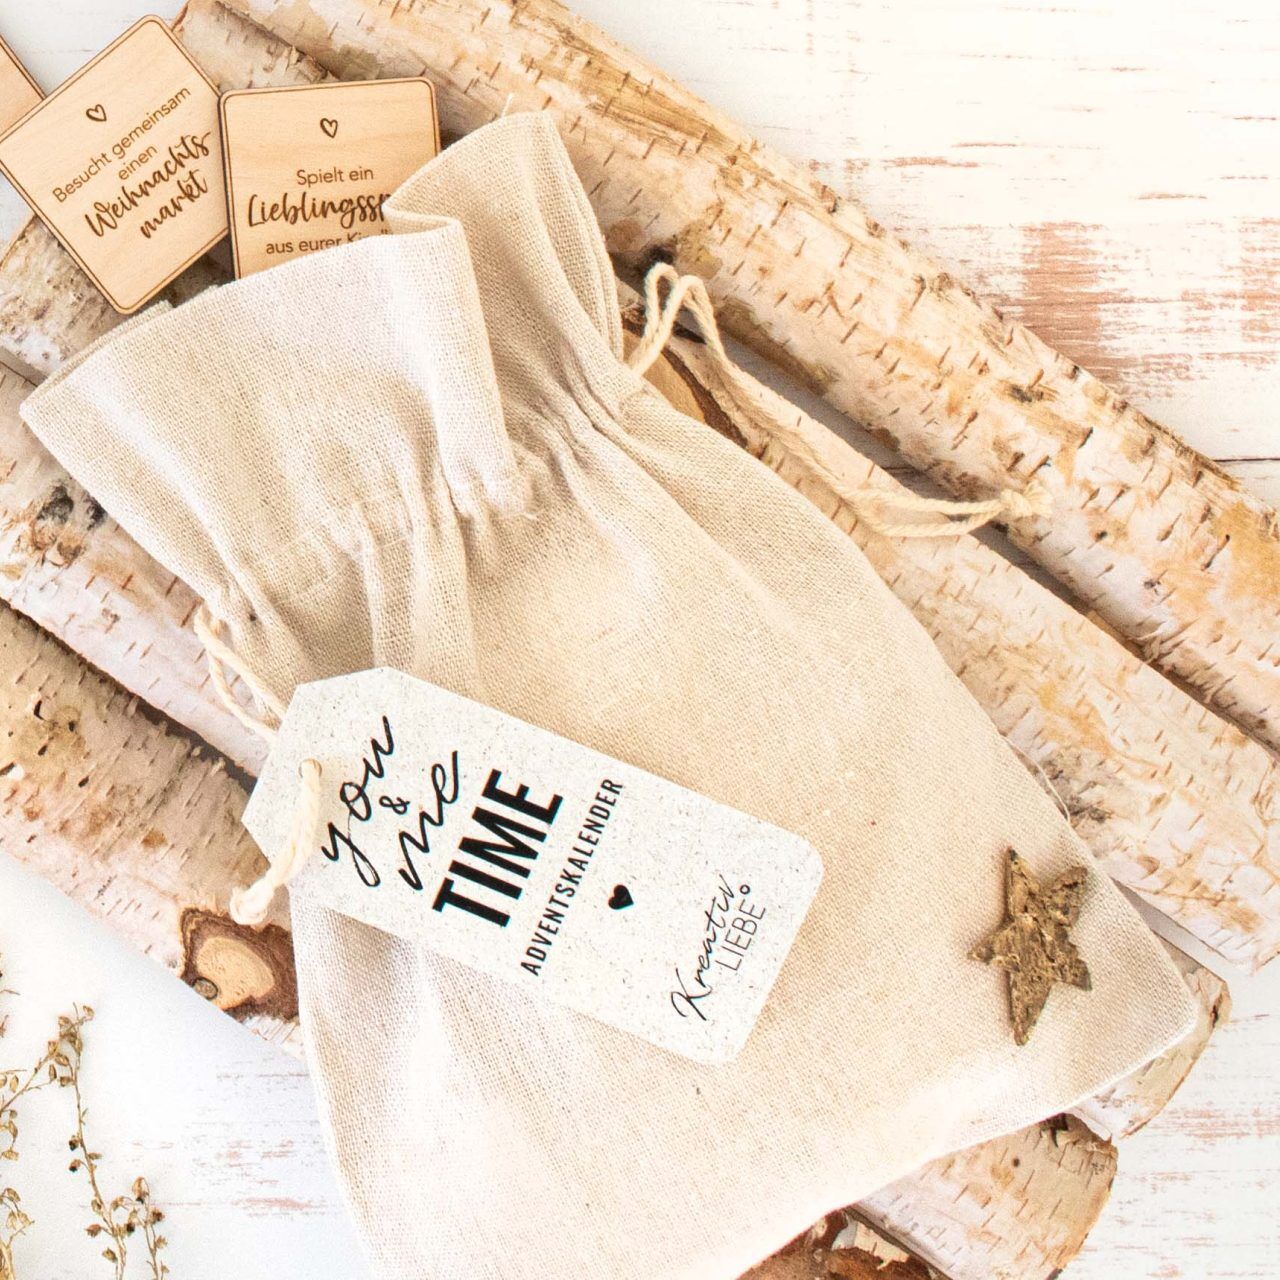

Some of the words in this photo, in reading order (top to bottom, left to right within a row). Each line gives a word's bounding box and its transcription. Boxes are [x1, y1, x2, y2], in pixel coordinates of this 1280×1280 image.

[51, 152, 113, 204] Besucht
[111, 87, 192, 160] gemeinsam
[84, 131, 212, 238] Weihnachts-
[118, 145, 158, 181] einen
[296, 166, 345, 188] Spielt
[348, 166, 374, 182] ein
[139, 168, 209, 239] markt
[265, 241, 294, 255] aus
[298, 237, 343, 253] eurer
[320, 715, 395, 888] you
[378, 795, 411, 816] &
[397, 750, 460, 891] me
[431, 768, 564, 928] TIME
[520, 778, 624, 977] ADVENTSKALENDER
[670, 873, 747, 1022] Kreativ
